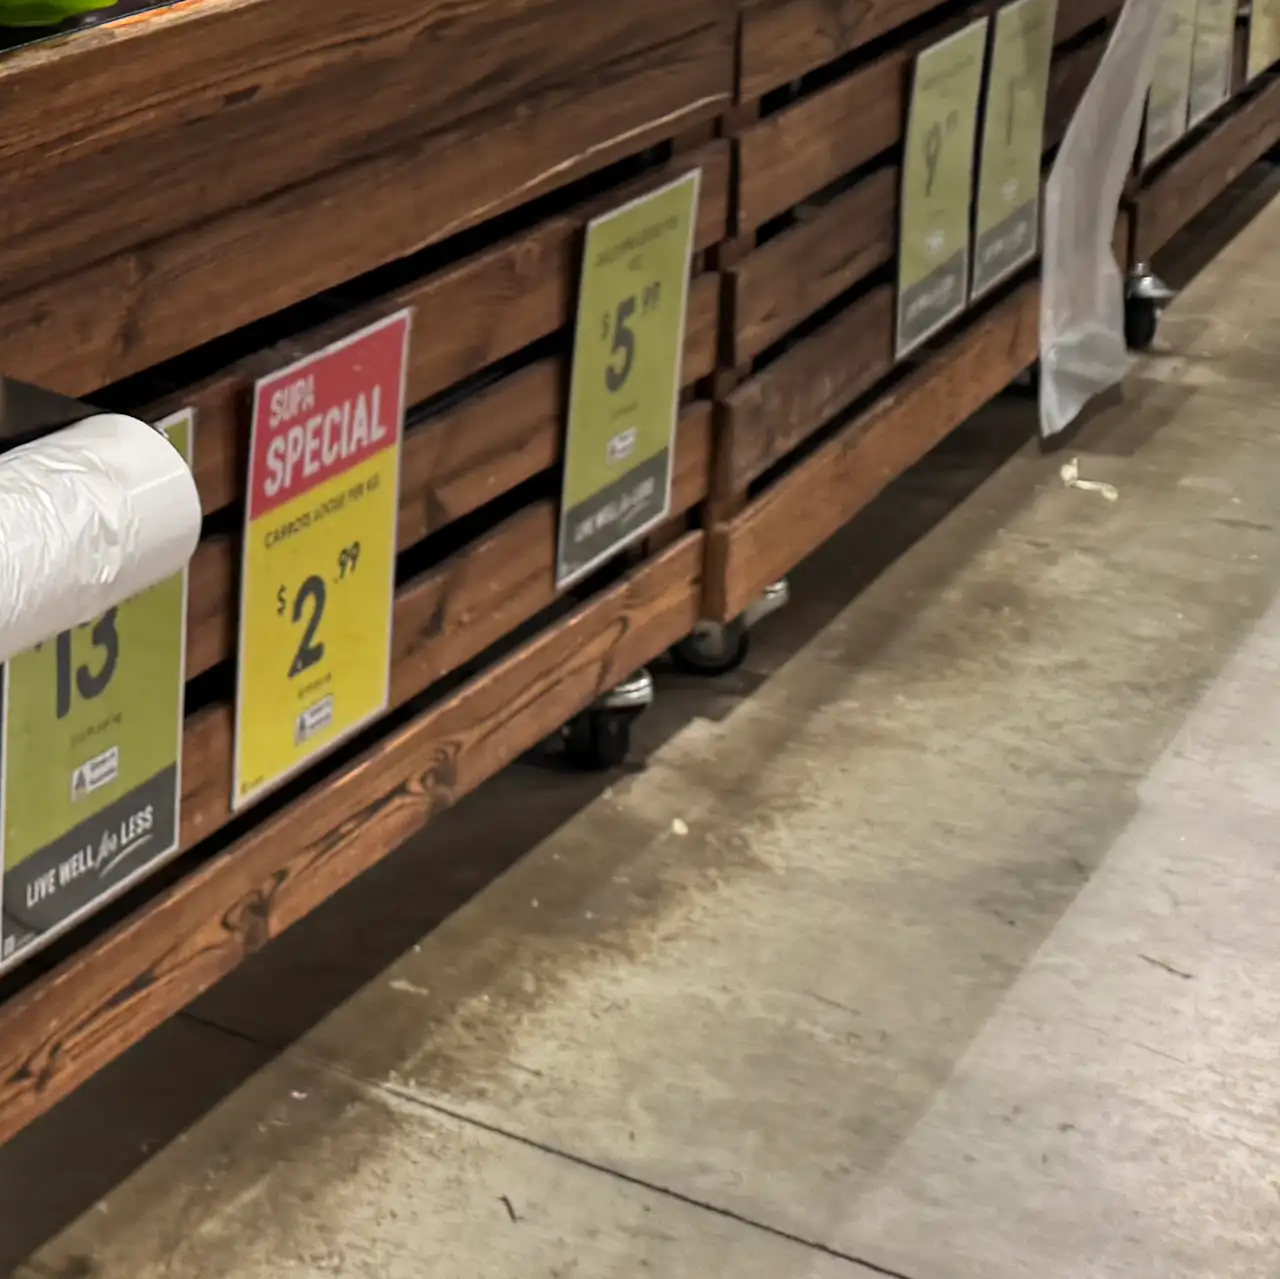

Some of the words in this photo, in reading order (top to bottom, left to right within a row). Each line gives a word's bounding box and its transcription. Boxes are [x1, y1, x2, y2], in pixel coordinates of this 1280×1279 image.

[263, 384, 388, 498] SPECIAL
[270, 374, 315, 429] SUPA
[25, 868, 57, 908] LIVE
[59, 844, 95, 888] WELL
[120, 804, 154, 847] LESS
